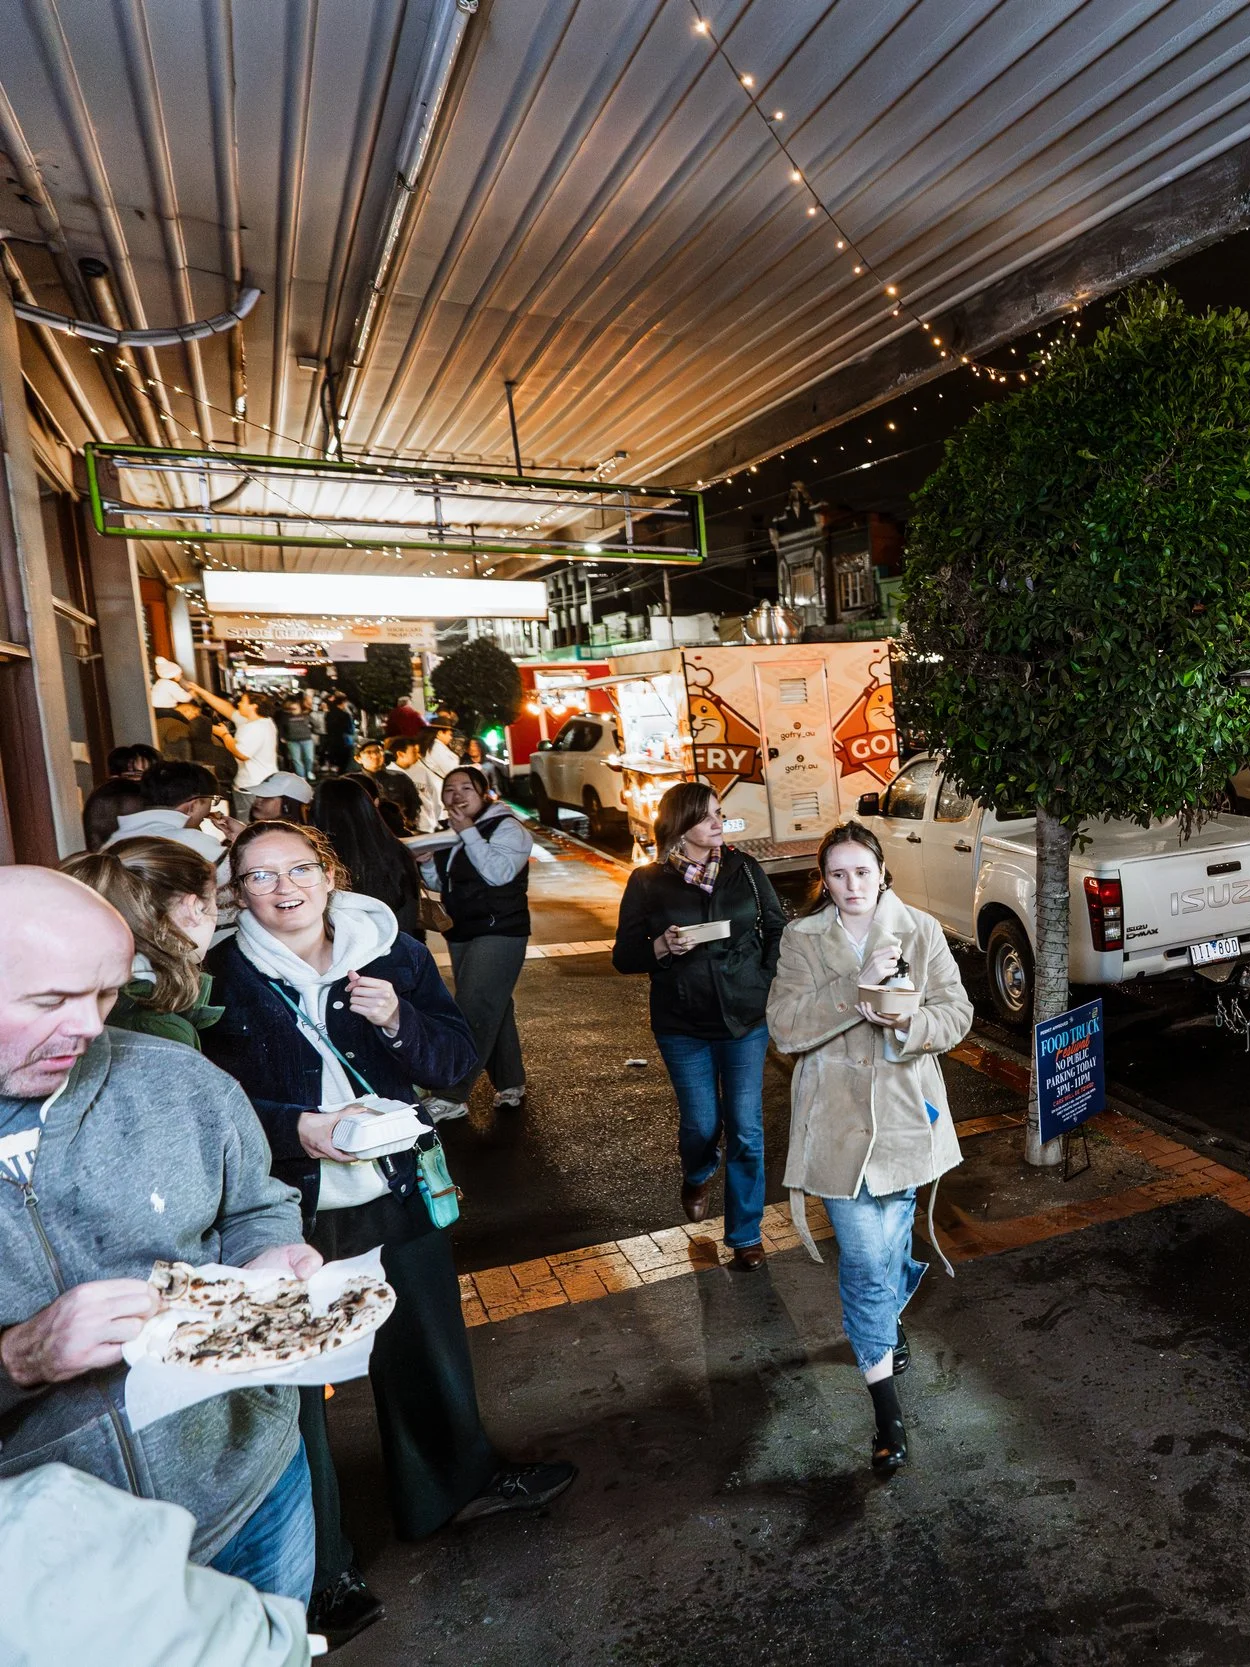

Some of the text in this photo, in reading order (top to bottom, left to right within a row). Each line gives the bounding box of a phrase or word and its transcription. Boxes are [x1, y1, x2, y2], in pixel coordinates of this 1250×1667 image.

[780, 731, 816, 741] gofry_au
[1126, 924, 1148, 932] ISUZU
[1126, 928, 1159, 940] D-MAX
[1041, 1016, 1100, 1057] FOOD TRUCK
[1056, 1034, 1091, 1062] Festival
[1046, 1055, 1097, 1090] PARKING TODAY
[1055, 1047, 1090, 1072] NO PUBLIC
[1056, 1081, 1070, 1098] 3PM
[1074, 1071, 1091, 1088] 11PM
